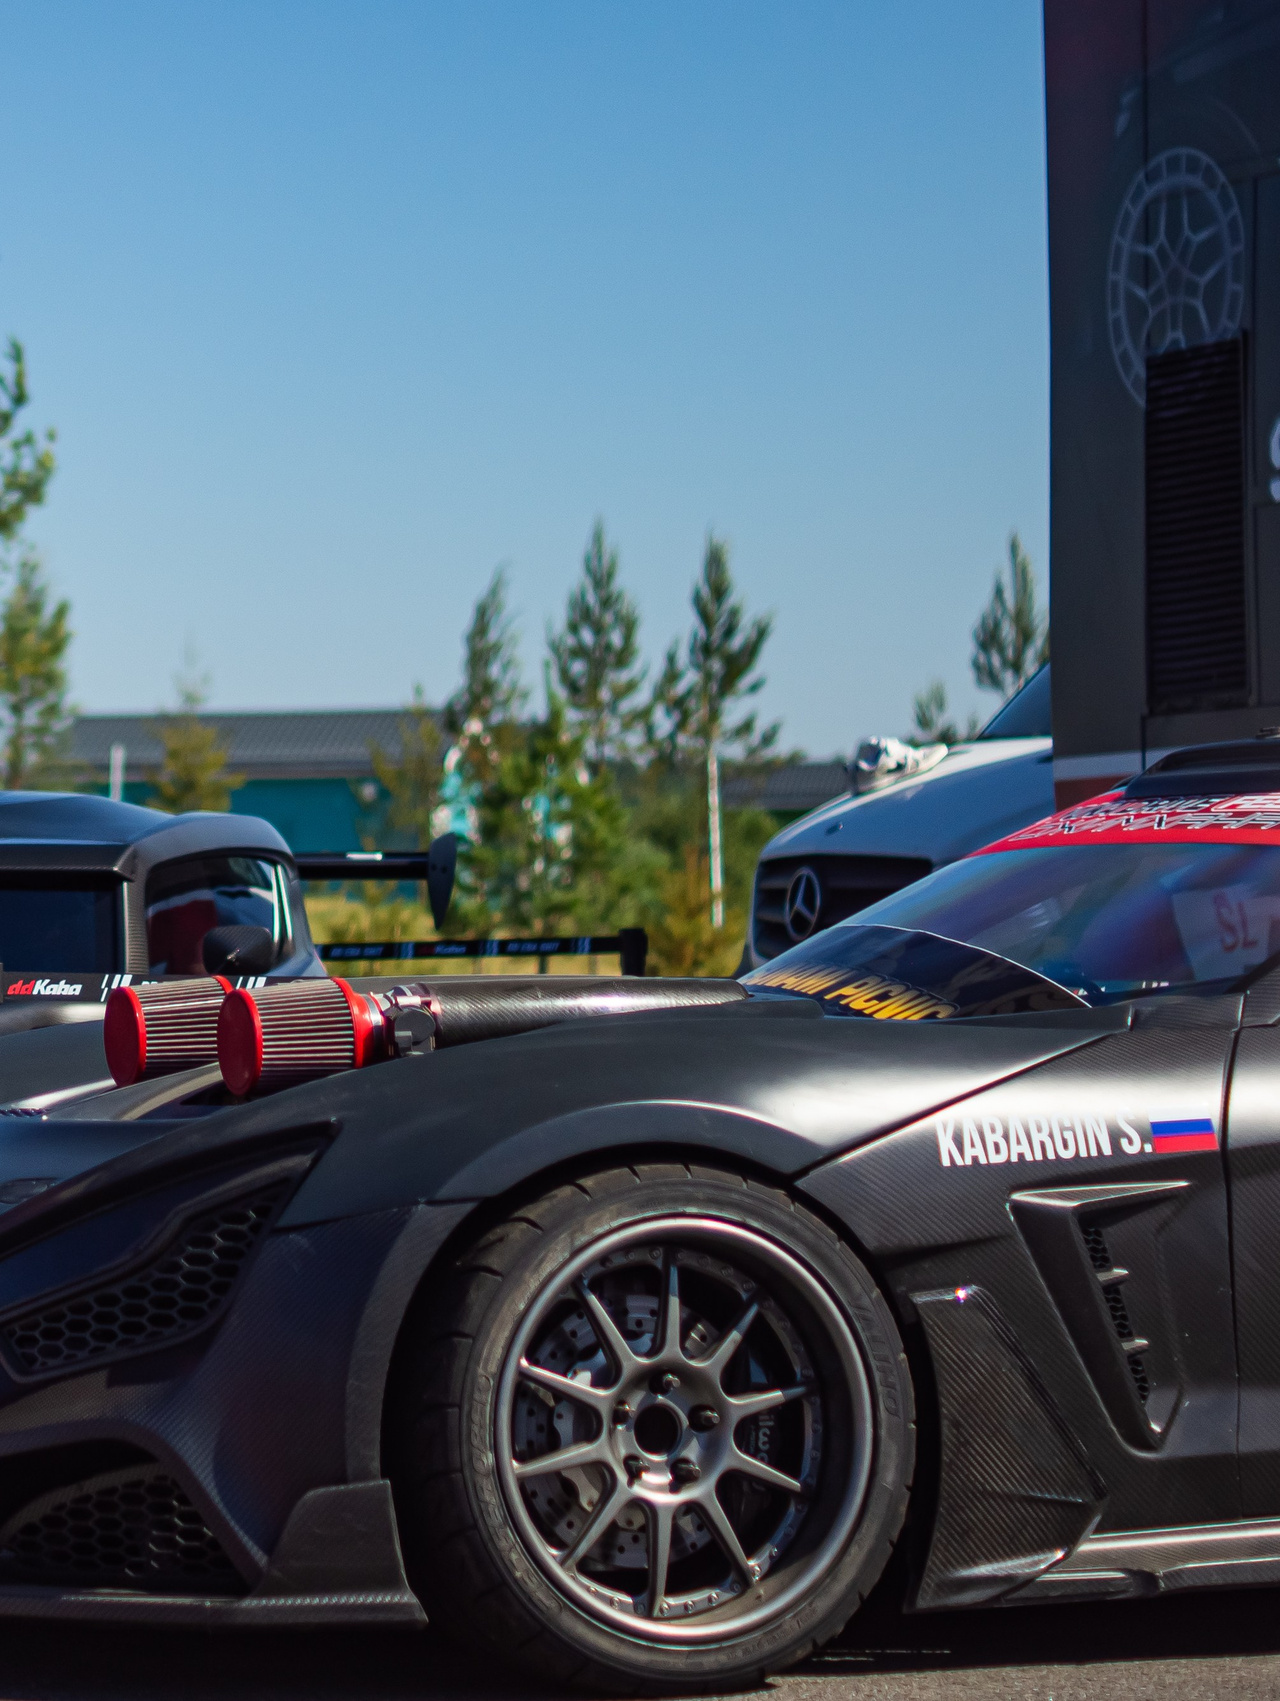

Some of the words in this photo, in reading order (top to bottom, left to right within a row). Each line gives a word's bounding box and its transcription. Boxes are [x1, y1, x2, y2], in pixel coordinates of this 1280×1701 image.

[7, 979, 83, 996] ddKaba
[934, 1113, 1113, 1168] KABARGIN
[1116, 1108, 1154, 1155] S.
